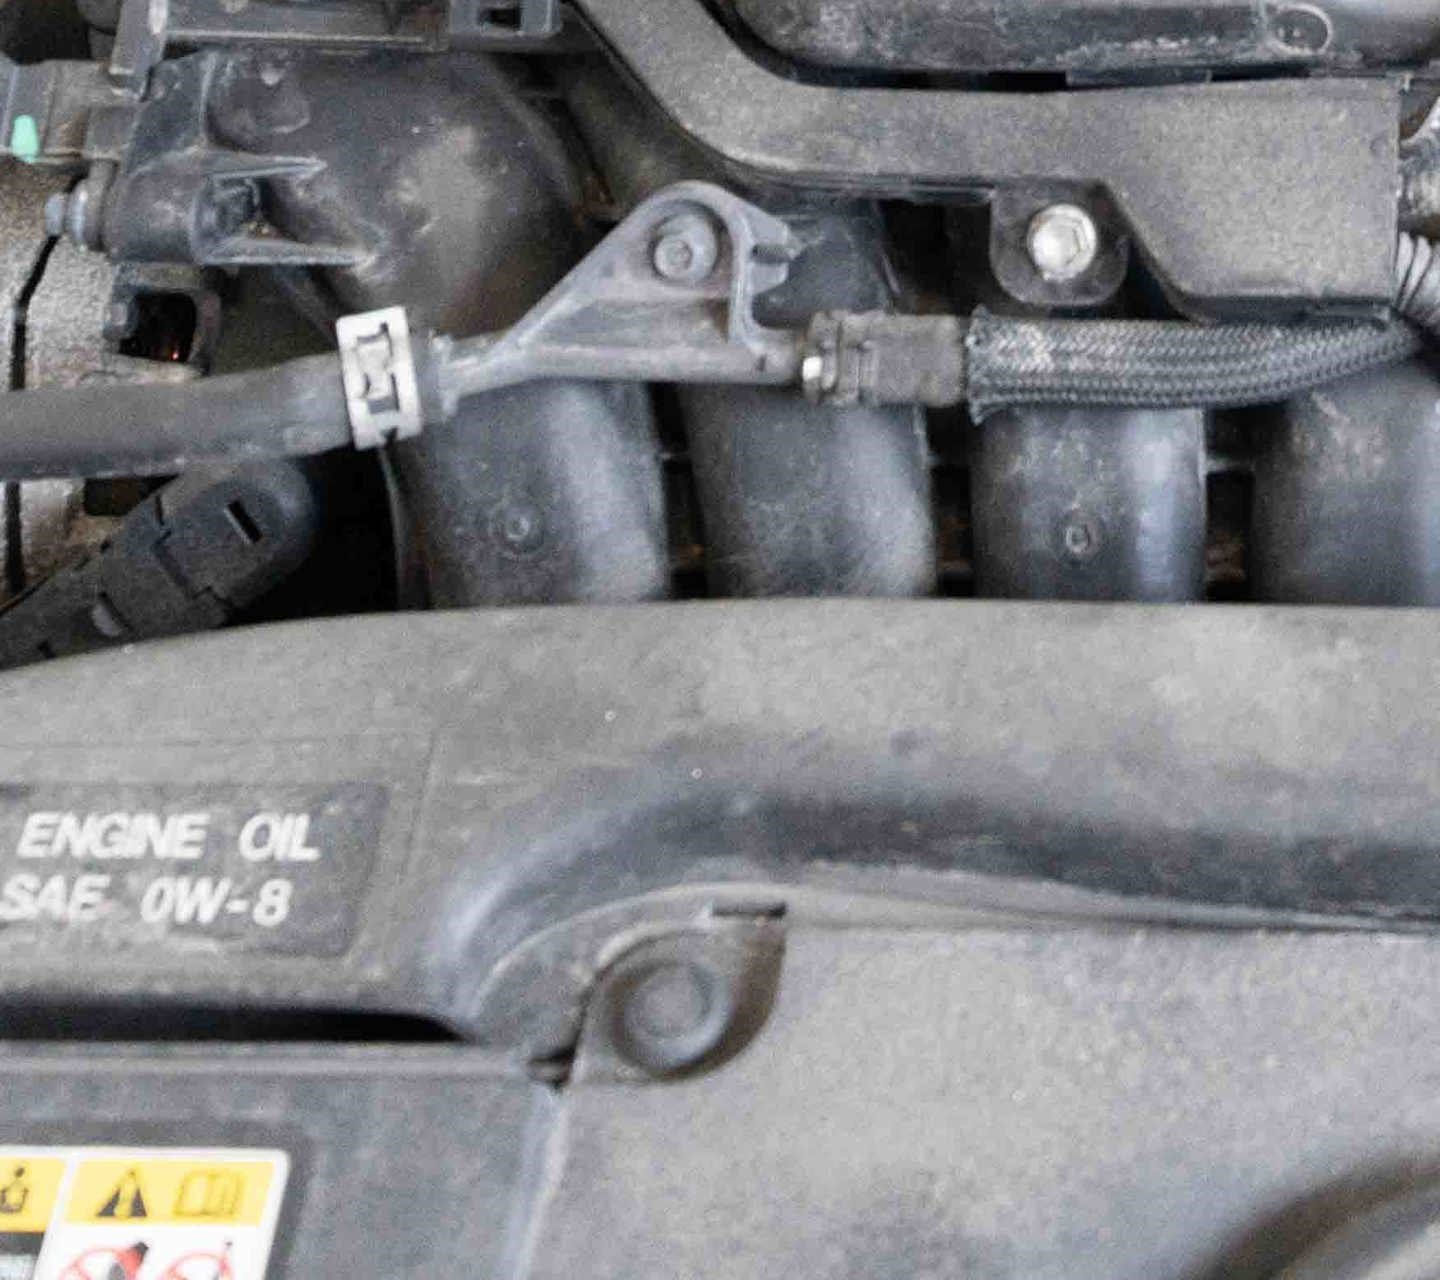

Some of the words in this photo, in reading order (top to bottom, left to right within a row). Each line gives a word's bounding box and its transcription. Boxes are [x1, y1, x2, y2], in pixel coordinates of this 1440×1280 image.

[15, 810, 208, 860] ENGINE
[237, 811, 323, 861] OIL
[139, 876, 294, 928] 0W-8
